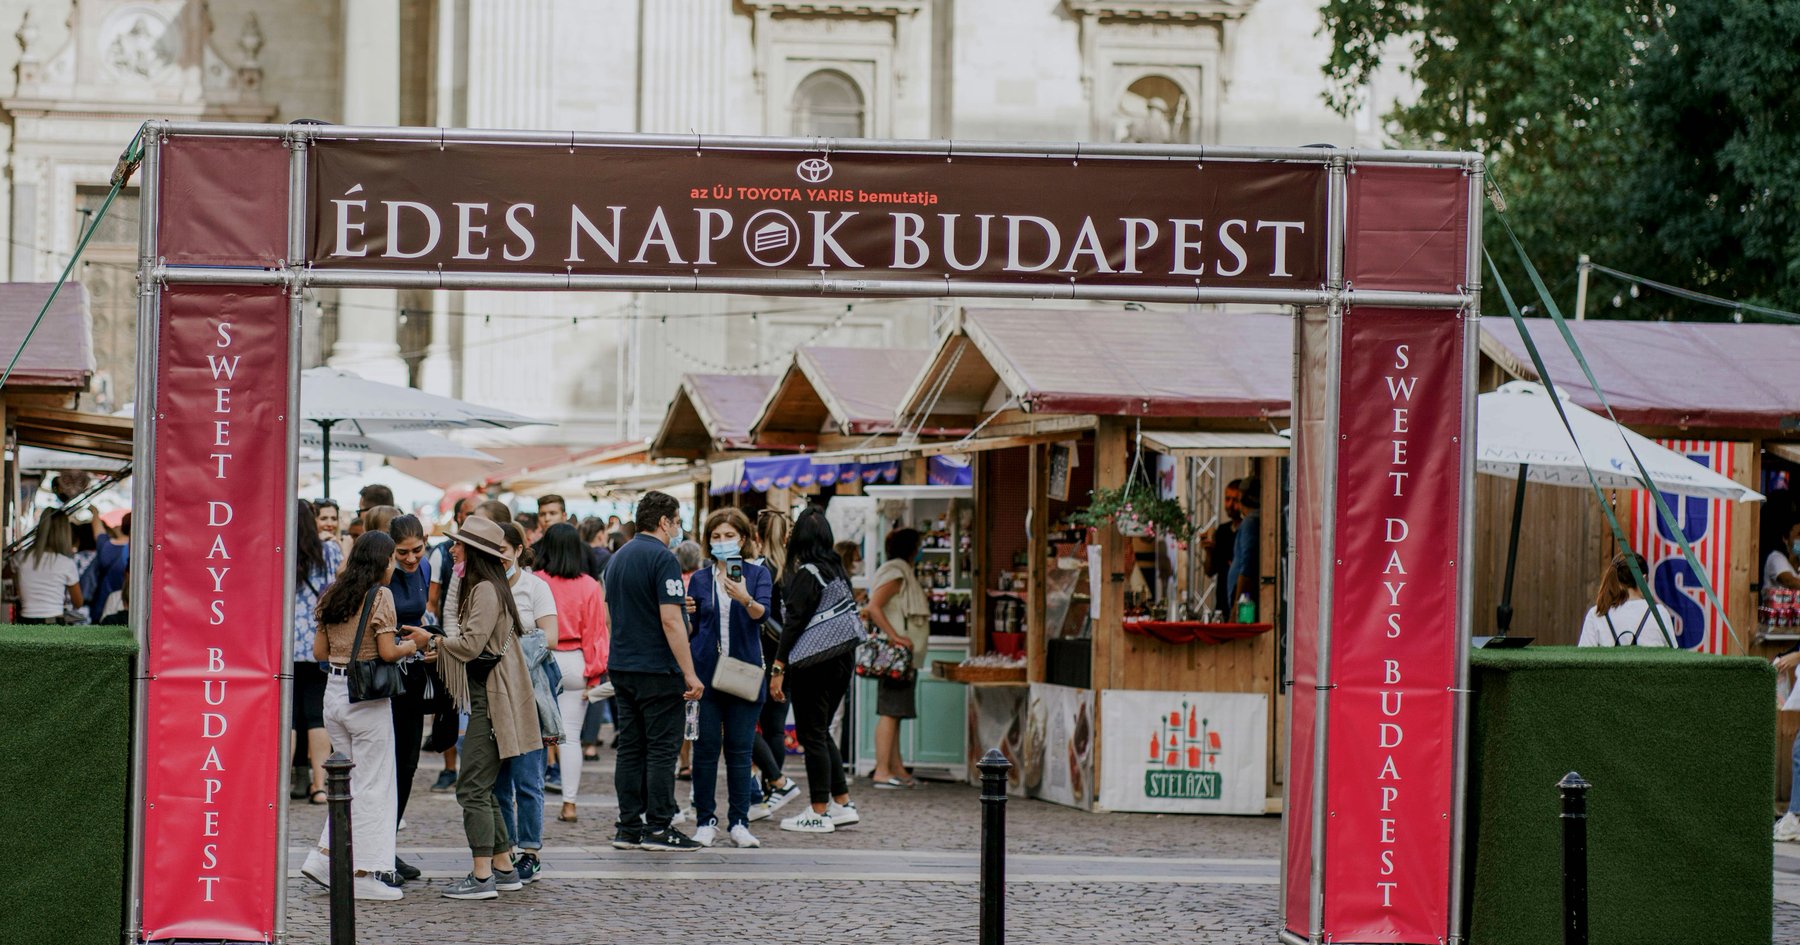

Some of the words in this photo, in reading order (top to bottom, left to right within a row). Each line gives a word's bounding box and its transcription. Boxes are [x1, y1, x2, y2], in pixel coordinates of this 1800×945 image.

[330, 183, 535, 262] ÉDES
[888, 213, 1305, 277] BUDAPEST
[690, 188, 708, 199] az
[712, 183, 733, 200] ÚJ
[737, 187, 801, 201] TOYOTA
[807, 189, 854, 202] YARIS
[858, 190, 939, 206] bemutatja
[206, 322, 241, 479] SWEET
[1385, 344, 1419, 496] SWEET
[206, 501, 233, 625] DAYS
[1382, 518, 1409, 638] DAYS
[198, 647, 228, 902] BUDAPEST
[796, 819, 825, 828] KARL
[1376, 659, 1404, 907] BUDAPEST
